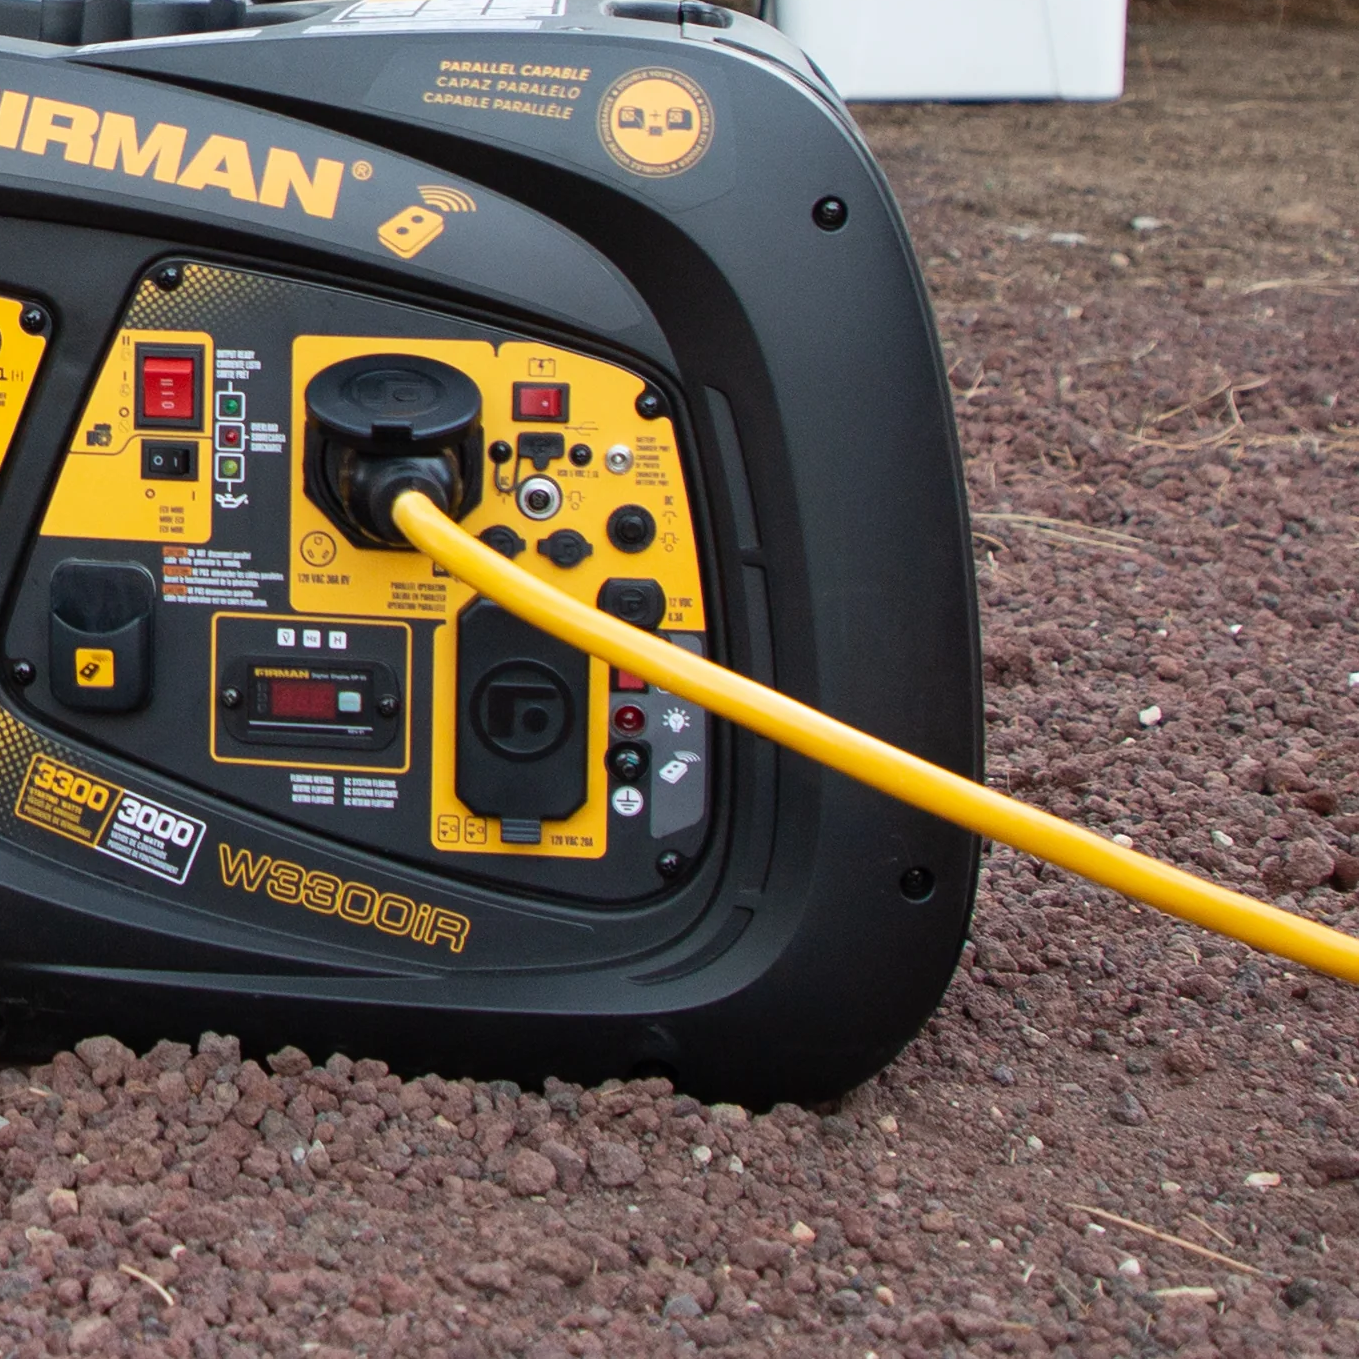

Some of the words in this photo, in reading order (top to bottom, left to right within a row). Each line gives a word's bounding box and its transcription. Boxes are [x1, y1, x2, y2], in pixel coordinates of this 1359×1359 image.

[439, 60, 517, 75] PARALLEL
[519, 64, 591, 81] CAPABLE
[435, 76, 493, 90] CAPAZ
[496, 80, 581, 100] PARALELO
[423, 92, 491, 109] CAPABLE
[297, 573, 310, 583] 120
[311, 573, 325, 584] VAC
[678, 598, 693, 608] VDC
[254, 667, 310, 679] FIRMAN
[34, 763, 109, 811] 3300
[117, 797, 195, 847] 3000
[551, 835, 563, 846] 120
[565, 835, 578, 846] VAC
[219, 843, 470, 952] W3300iR
